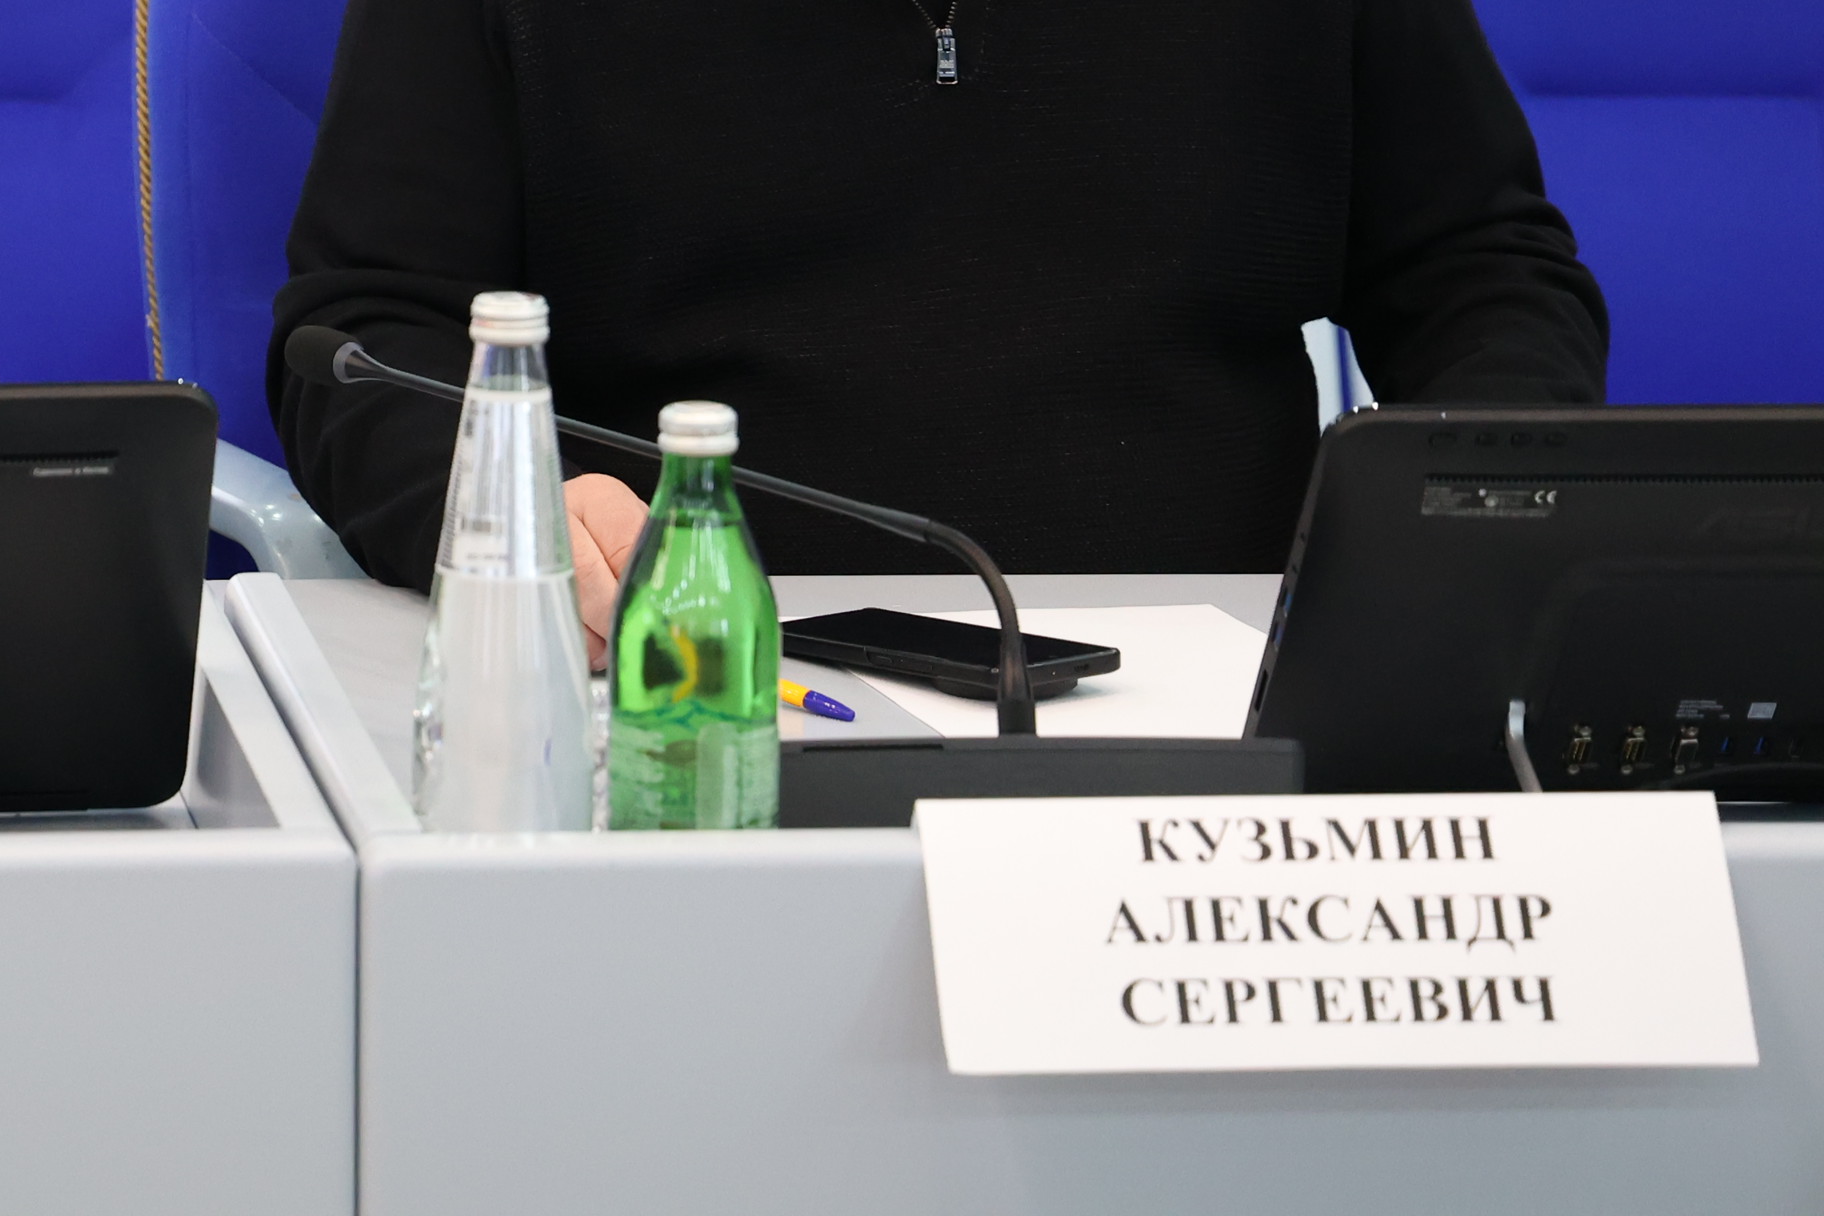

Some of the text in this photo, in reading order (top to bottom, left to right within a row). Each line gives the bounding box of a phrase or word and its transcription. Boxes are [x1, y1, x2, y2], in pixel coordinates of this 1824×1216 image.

[1137, 816, 1496, 864] КУЗЬМИН
[1106, 894, 1553, 952] АЛЕКСАНДР
[1119, 975, 1557, 1027] СЕРГЕЕВИЧ
